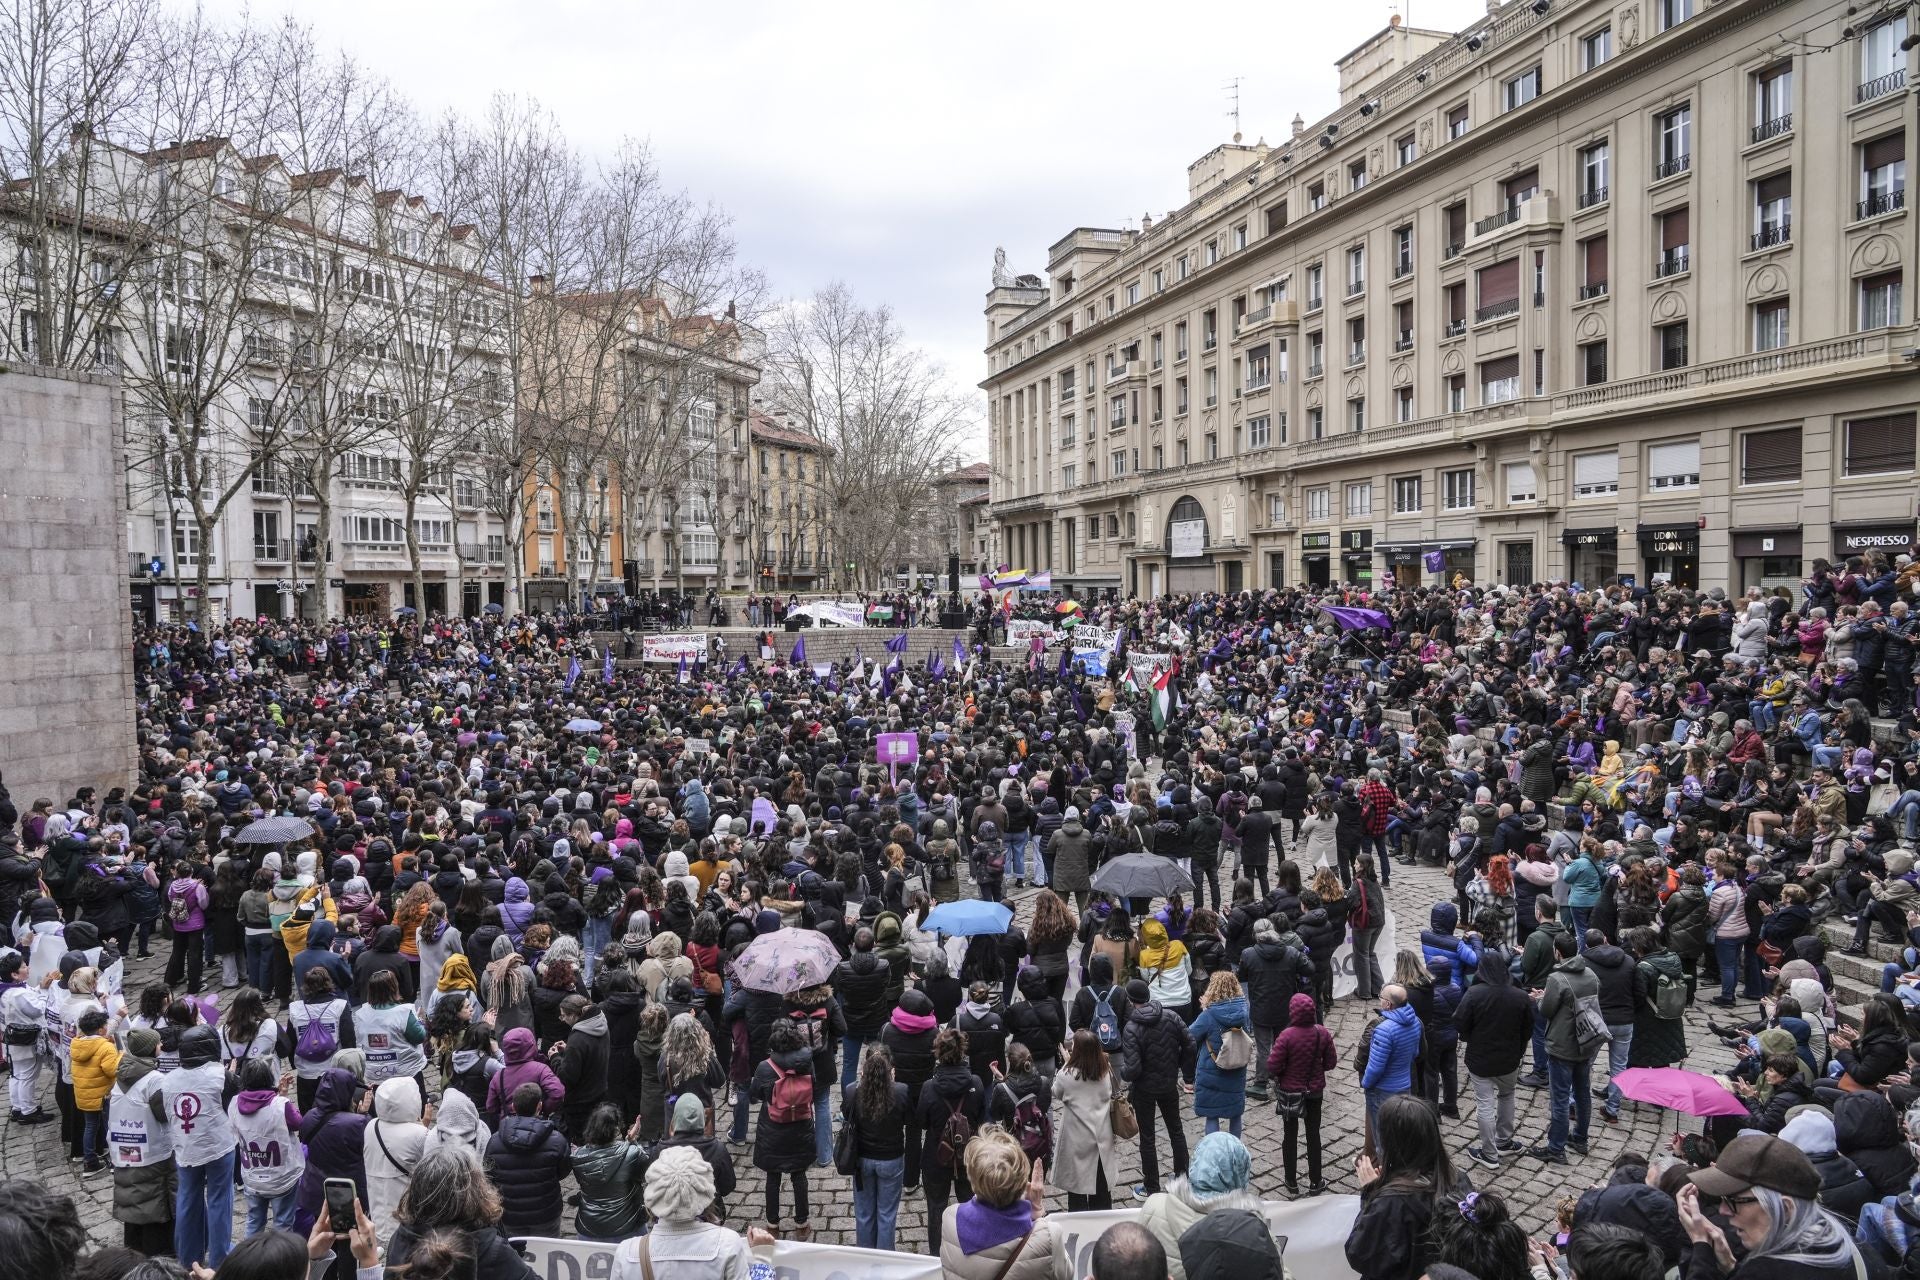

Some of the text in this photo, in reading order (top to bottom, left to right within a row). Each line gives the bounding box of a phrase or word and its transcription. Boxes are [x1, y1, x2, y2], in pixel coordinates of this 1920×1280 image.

[1577, 535, 1598, 544] UDON
[1653, 531, 1677, 540] UDON
[1845, 534, 1909, 548] NESPRESSO
[1654, 541, 1683, 552] UDON
